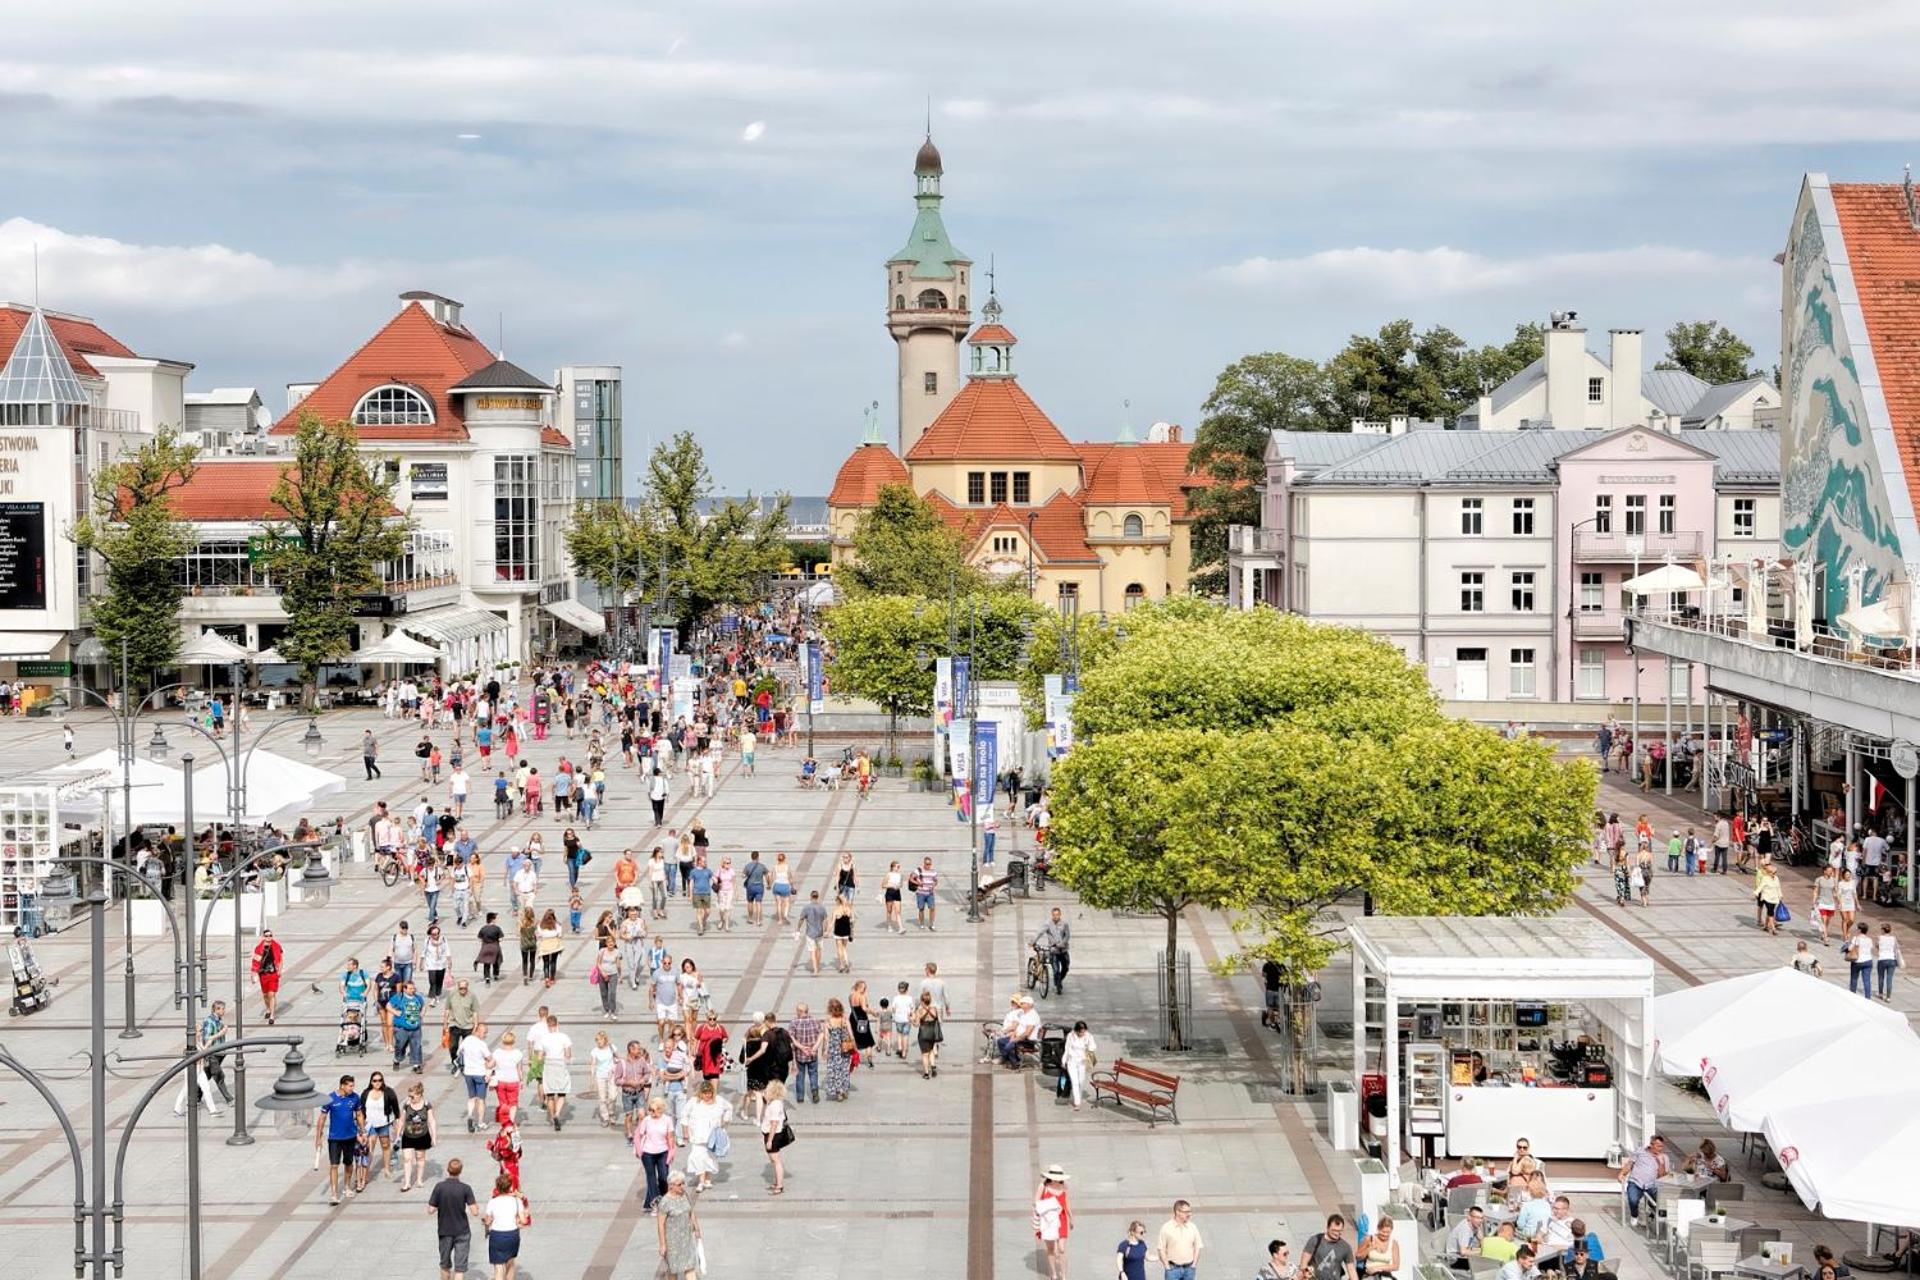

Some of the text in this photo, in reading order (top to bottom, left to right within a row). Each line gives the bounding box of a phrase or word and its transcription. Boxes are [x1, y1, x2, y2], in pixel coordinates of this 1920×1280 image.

[957, 752, 965, 773] VISA
[978, 740, 987, 802] Kino na molo
